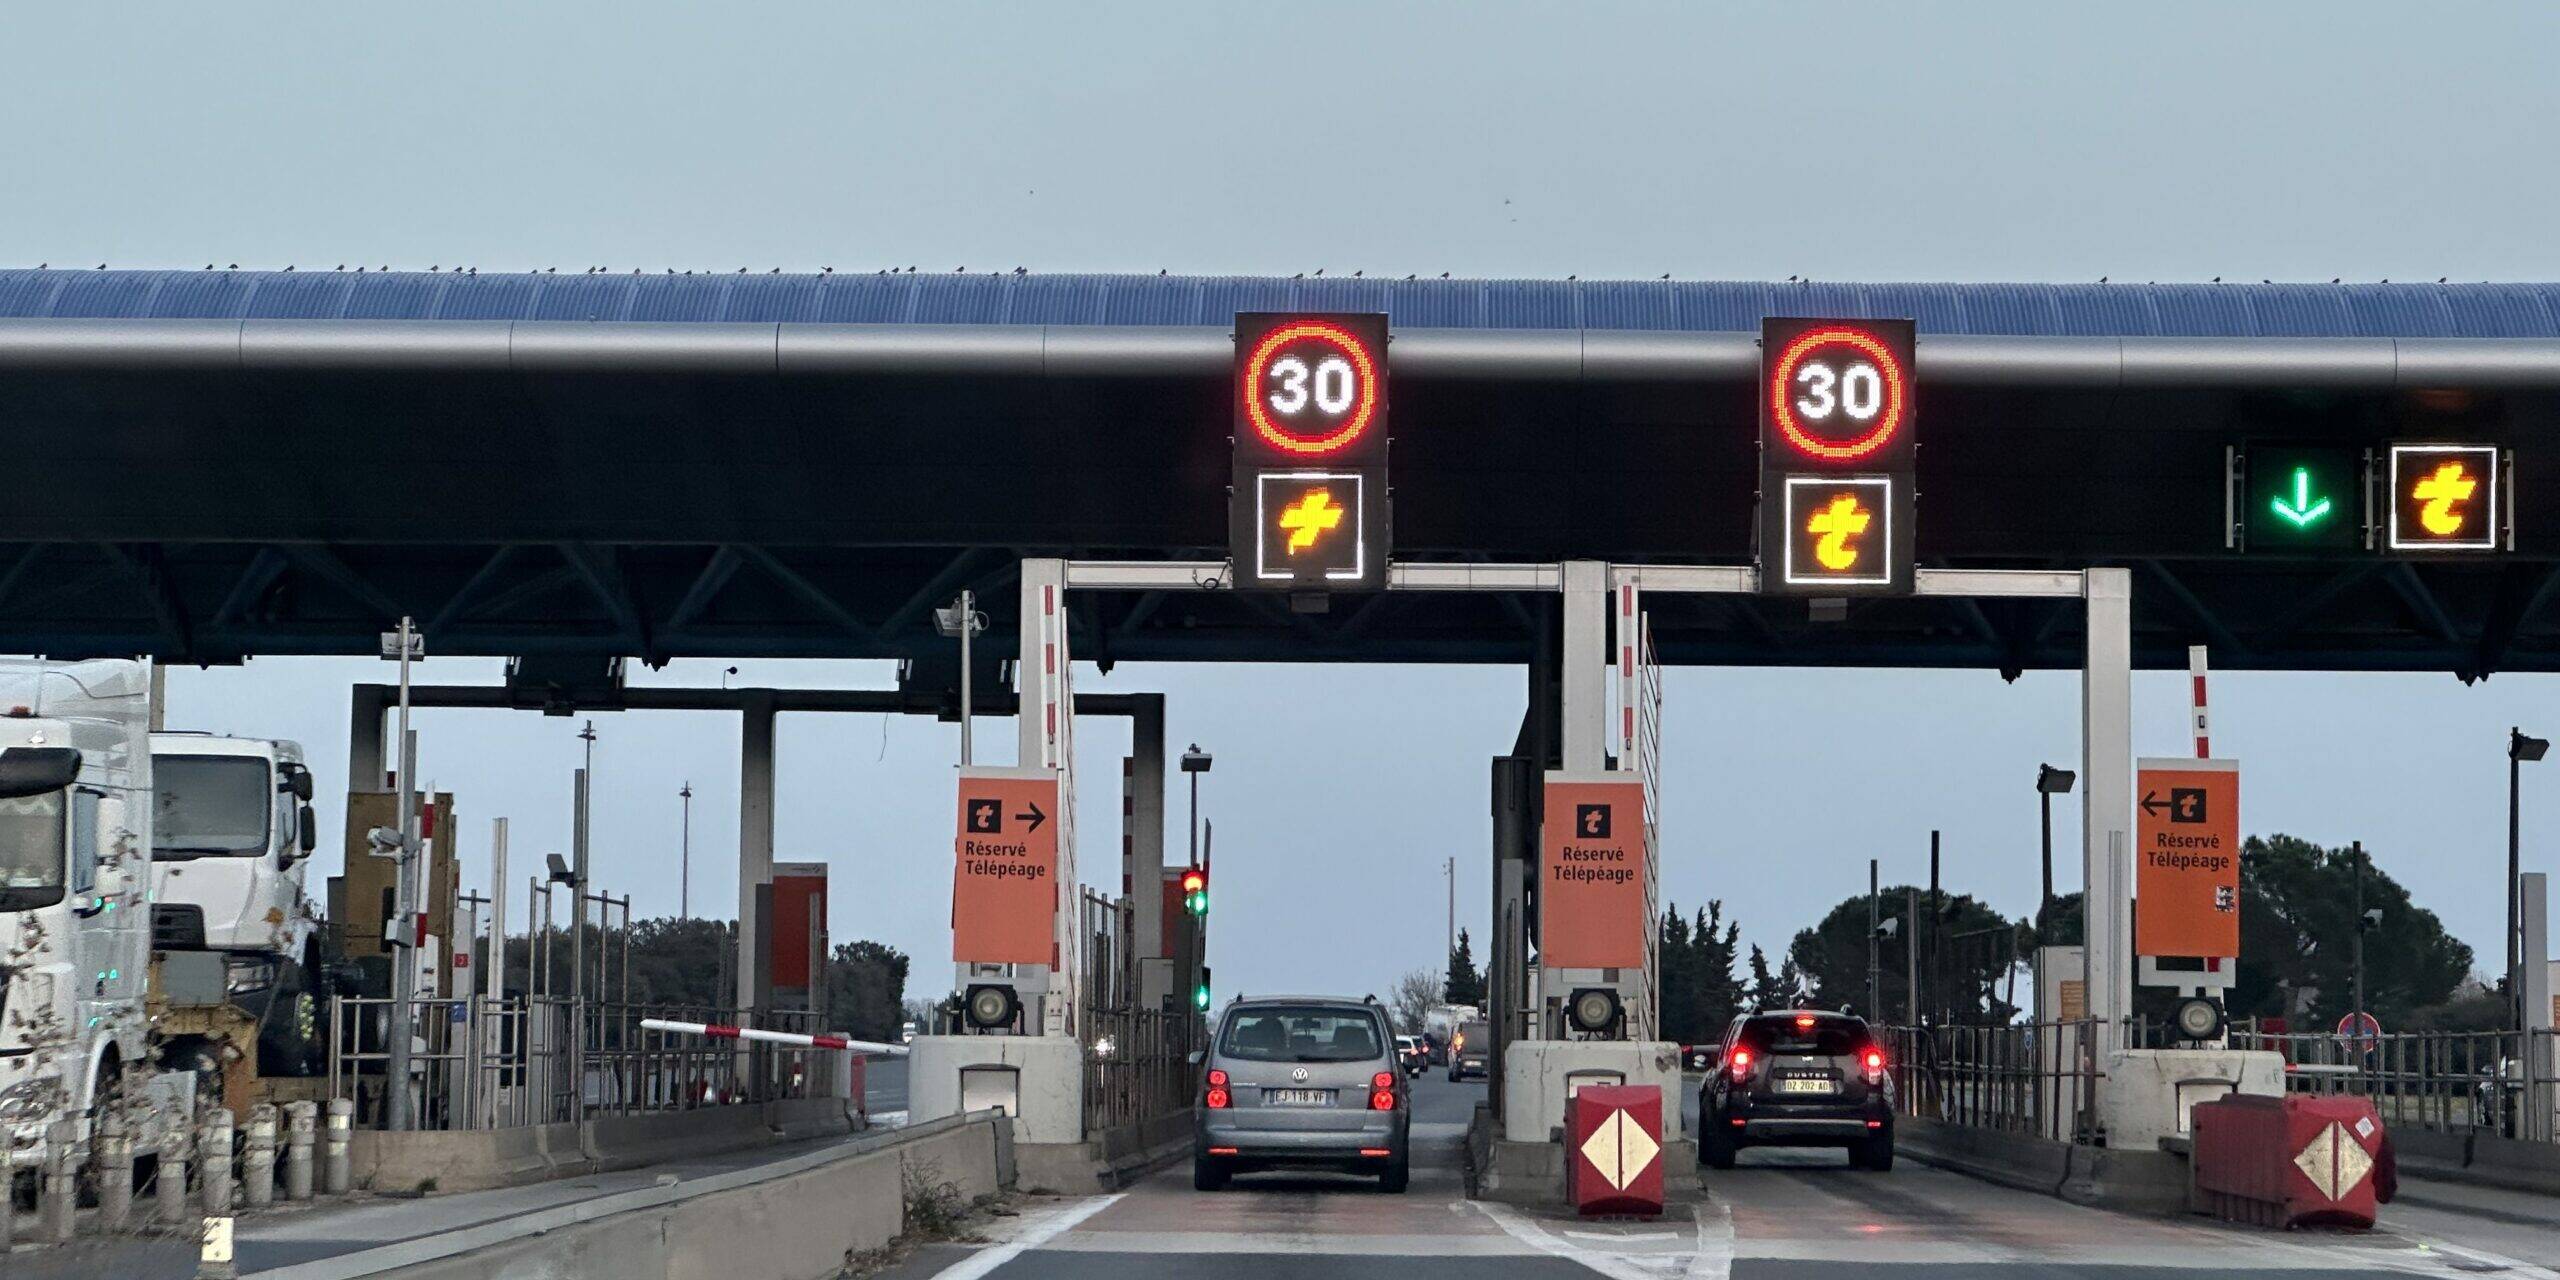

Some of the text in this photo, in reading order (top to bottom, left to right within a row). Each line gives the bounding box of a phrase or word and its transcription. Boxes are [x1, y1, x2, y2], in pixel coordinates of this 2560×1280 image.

[1270, 354, 1353, 413] 30
[1796, 361, 1881, 419] 30
[965, 840, 1026, 856] Réservé
[2157, 833, 2220, 848] Réservé
[1563, 846, 1624, 861] Réservé
[2147, 851, 2229, 872] Télépéage
[966, 860, 1045, 880] Télépéage
[1553, 865, 1634, 885] Télépéage
